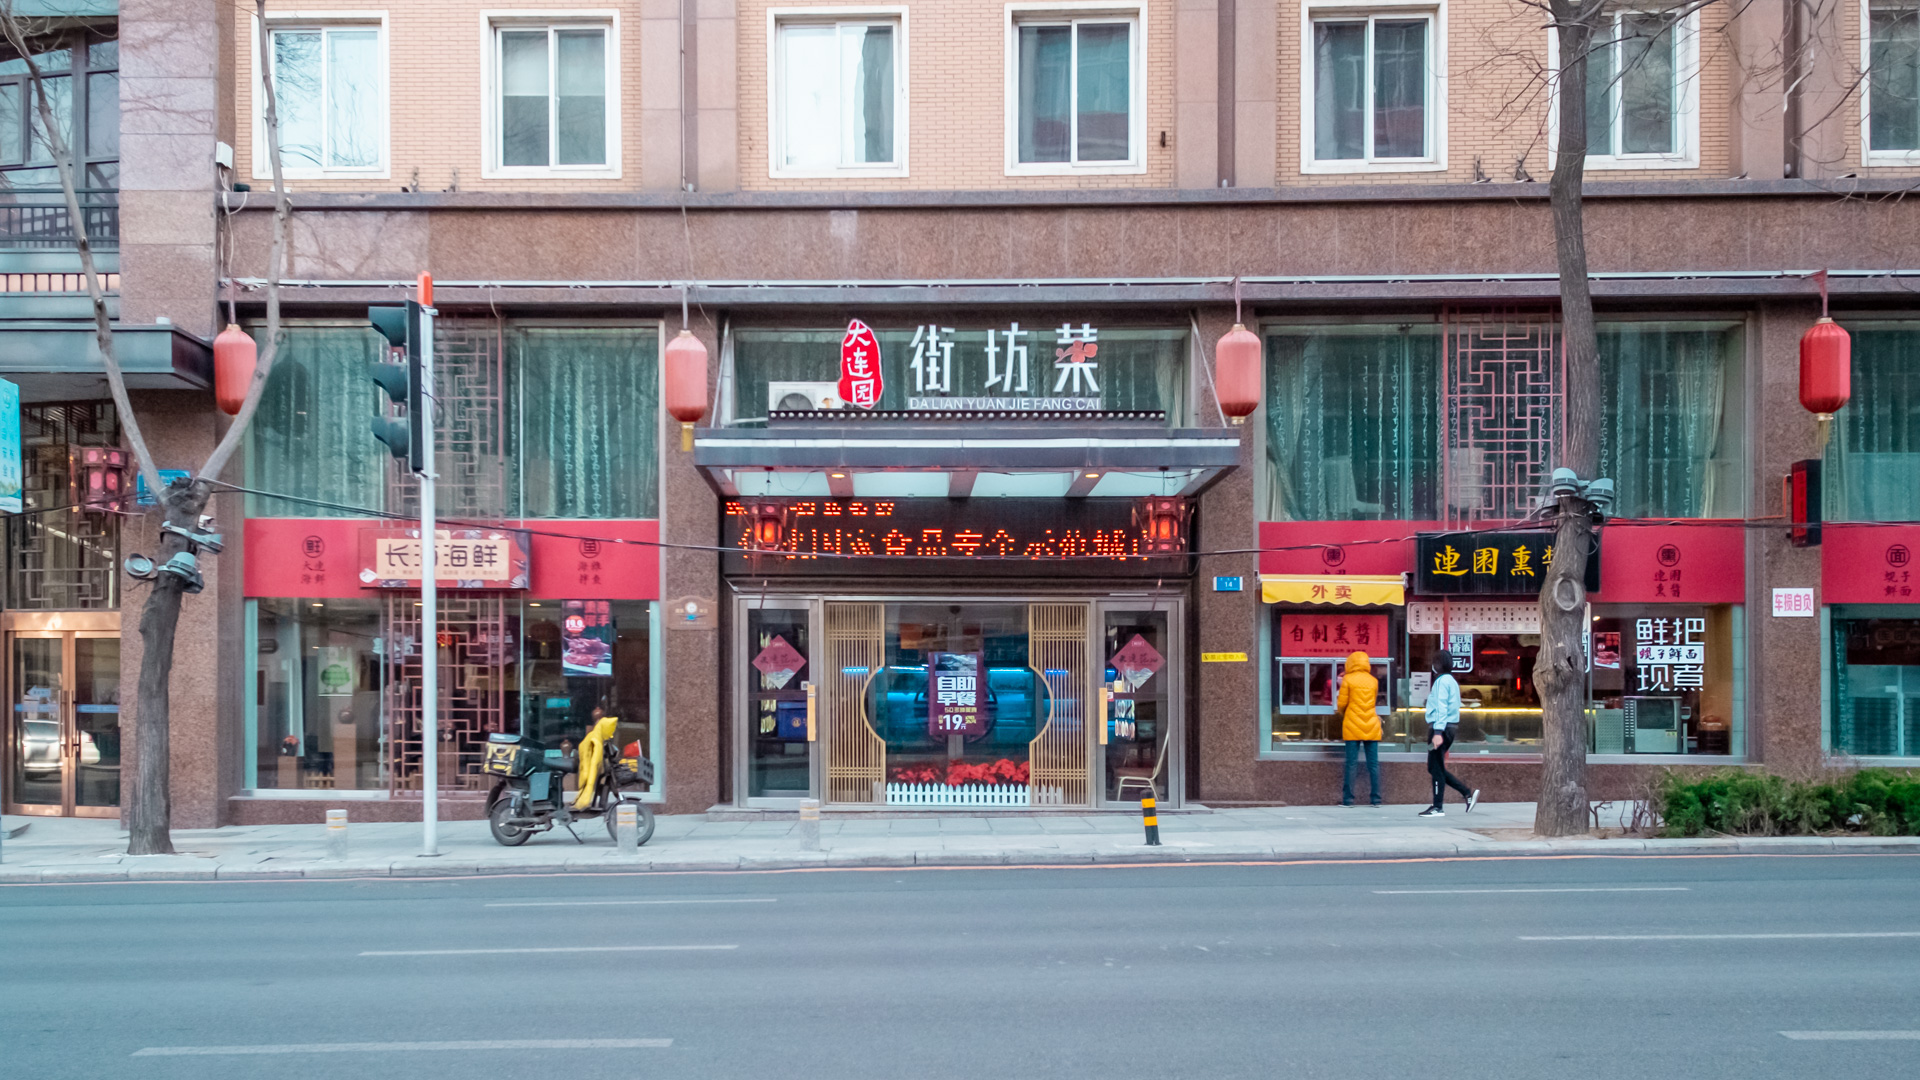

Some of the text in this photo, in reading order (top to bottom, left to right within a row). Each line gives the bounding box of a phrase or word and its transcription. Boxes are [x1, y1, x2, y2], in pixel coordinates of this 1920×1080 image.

[844, 325, 875, 406] 大连园
[909, 322, 1100, 392] 街坊菜
[966, 398, 1006, 410] YUAN
[1009, 398, 1030, 410] JIE
[1034, 398, 1072, 410] FANG
[1075, 398, 1100, 410] CAI
[1890, 549, 1906, 563] 面
[1311, 584, 1352, 599] 外卖
[1774, 592, 1813, 613] 车损自负
[1635, 617, 1706, 646] 鲜把
[937, 676, 976, 690] 自助
[1636, 664, 1705, 692] 现煮
[937, 691, 976, 706] 早餐
